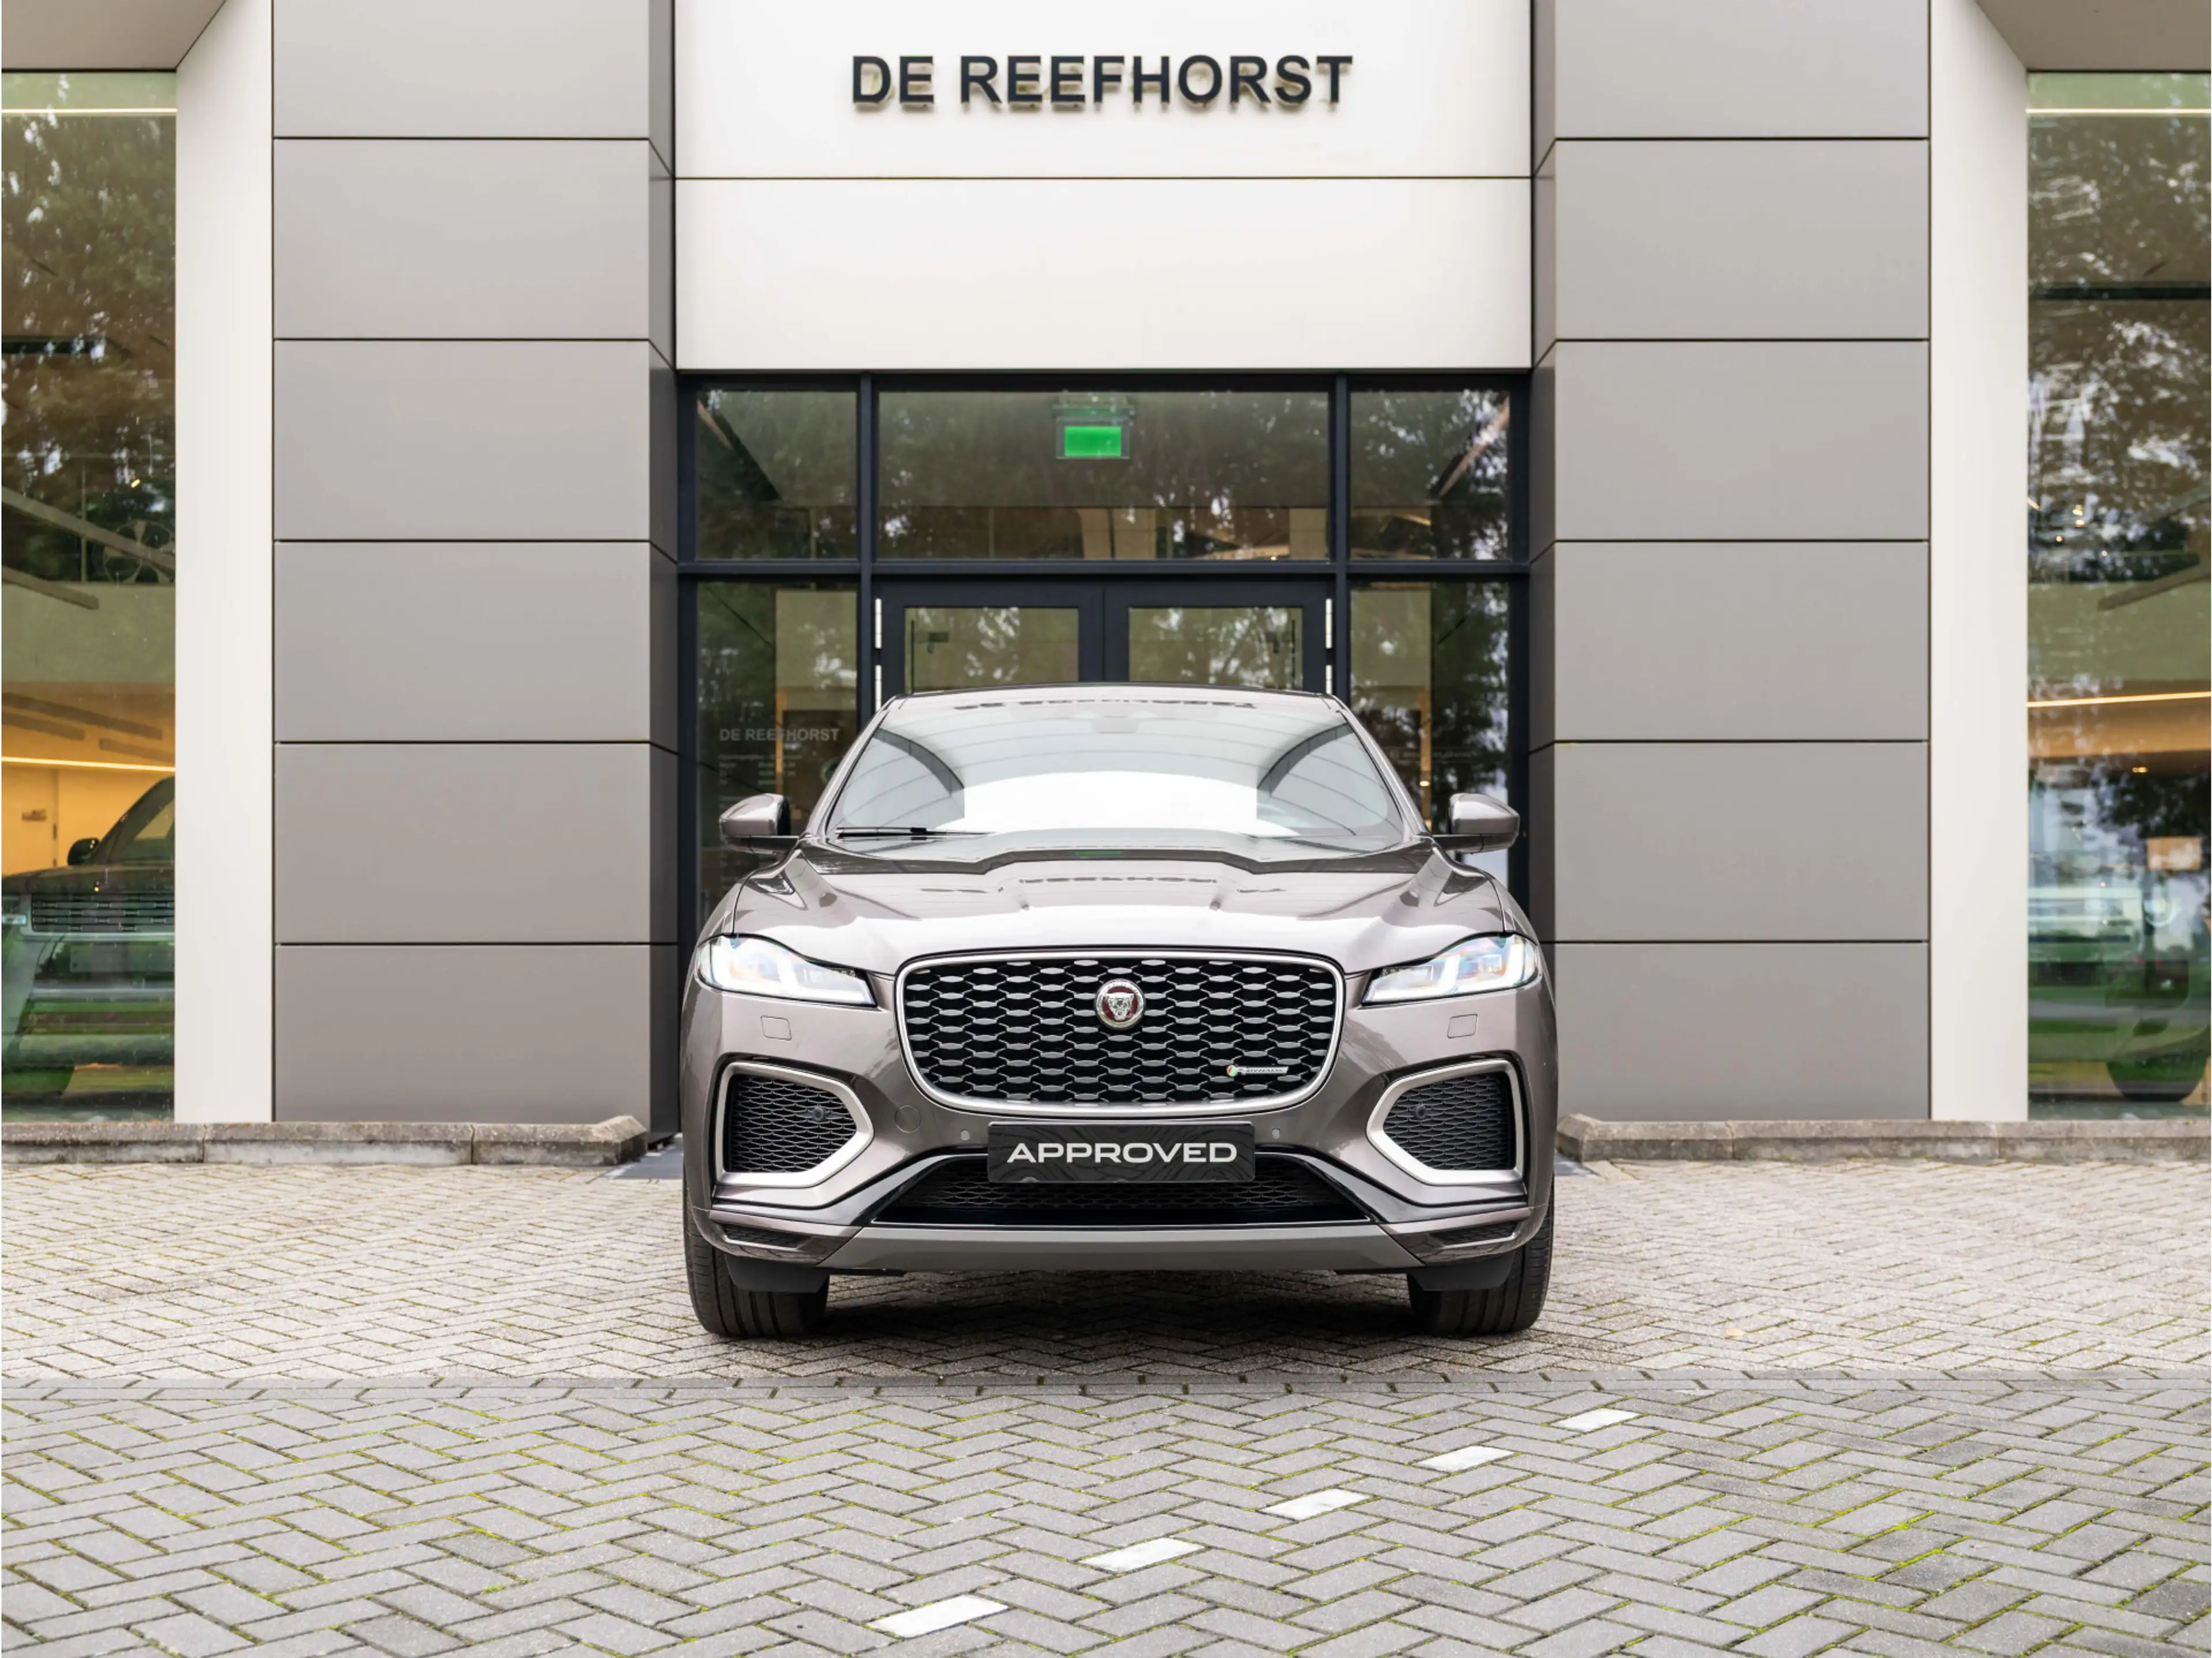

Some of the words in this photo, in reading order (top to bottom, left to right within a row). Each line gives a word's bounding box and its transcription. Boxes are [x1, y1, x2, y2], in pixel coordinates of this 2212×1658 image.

[853, 55, 934, 104] DE
[960, 55, 1353, 104] REEFHORST
[719, 728, 741, 741] DE
[1007, 1143, 1237, 1163] APPROVED
